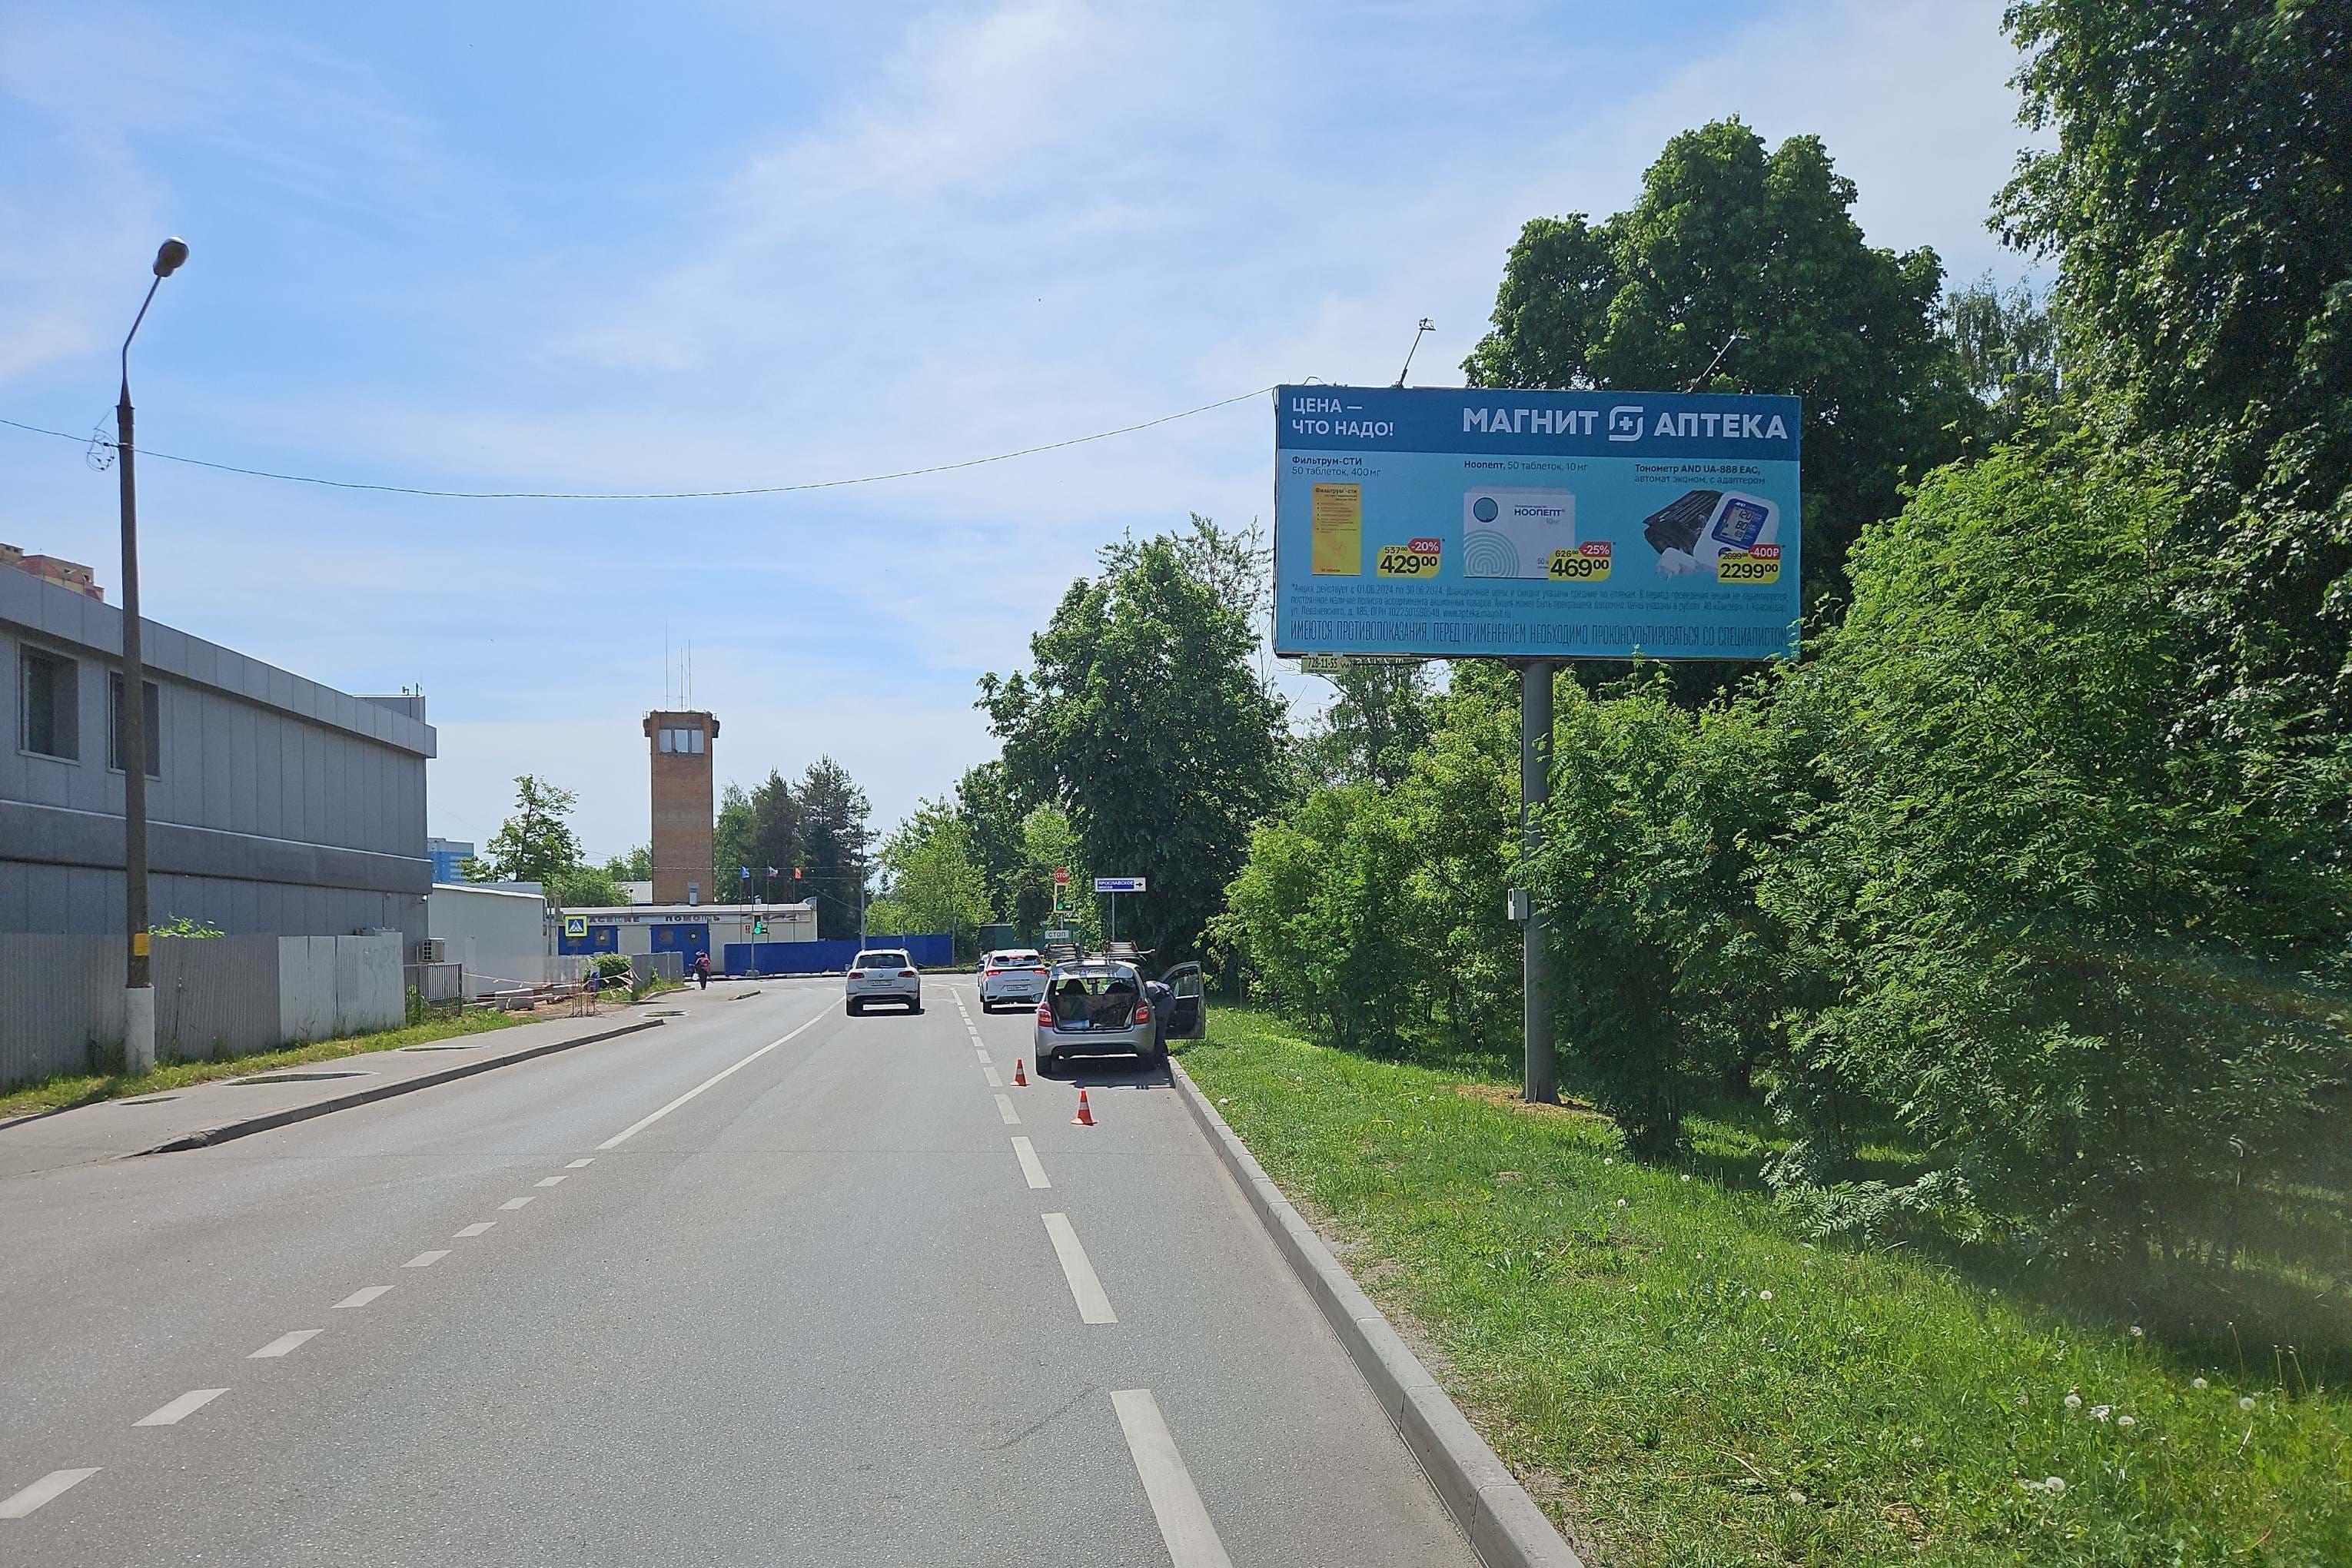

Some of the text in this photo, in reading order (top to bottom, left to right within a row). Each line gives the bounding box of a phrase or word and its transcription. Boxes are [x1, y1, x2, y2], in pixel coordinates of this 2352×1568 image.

[1292, 397, 1342, 414] ЦЕНА
[1292, 419, 1394, 438] ЧТО НАДО!
[1463, 407, 1789, 439] МАГНИТ АПТЕКА
[1291, 456, 1362, 467] Фильтрум-СТИ
[1464, 460, 1506, 470] Ноопепт,
[1507, 461, 1519, 470] 50
[1522, 461, 1564, 471] таблеток,
[1292, 467, 1304, 475] 50
[1307, 467, 1349, 477] таблеток,
[1635, 463, 1679, 474] Тонометр
[1681, 464, 1702, 473] AND
[1703, 465, 1737, 473] UA-888
[1634, 475, 1670, 483] автомат
[1716, 477, 1766, 485] адаптером
[1739, 510, 1752, 520] 120
[1736, 520, 1748, 530] 80
[1411, 541, 1439, 552] -20%
[1583, 545, 1610, 555] -25%
[1291, 620, 1333, 640] ИМЕЮТСЯ
[1337, 620, 1430, 643] ПРОТИВОПОКАЗАНИЯ,
[1433, 622, 1460, 644] ПЕРЕД
[1462, 623, 1526, 643] ПРИМЕНЕНИЕМ
[1530, 623, 1588, 646] НЕОБХОДИМО
[1592, 624, 1699, 646] ПРОКОНСУЛЬТИРОВАТЬСЯ
[1703, 626, 1715, 646] СО
[1307, 656, 1338, 669] 728-11-55
